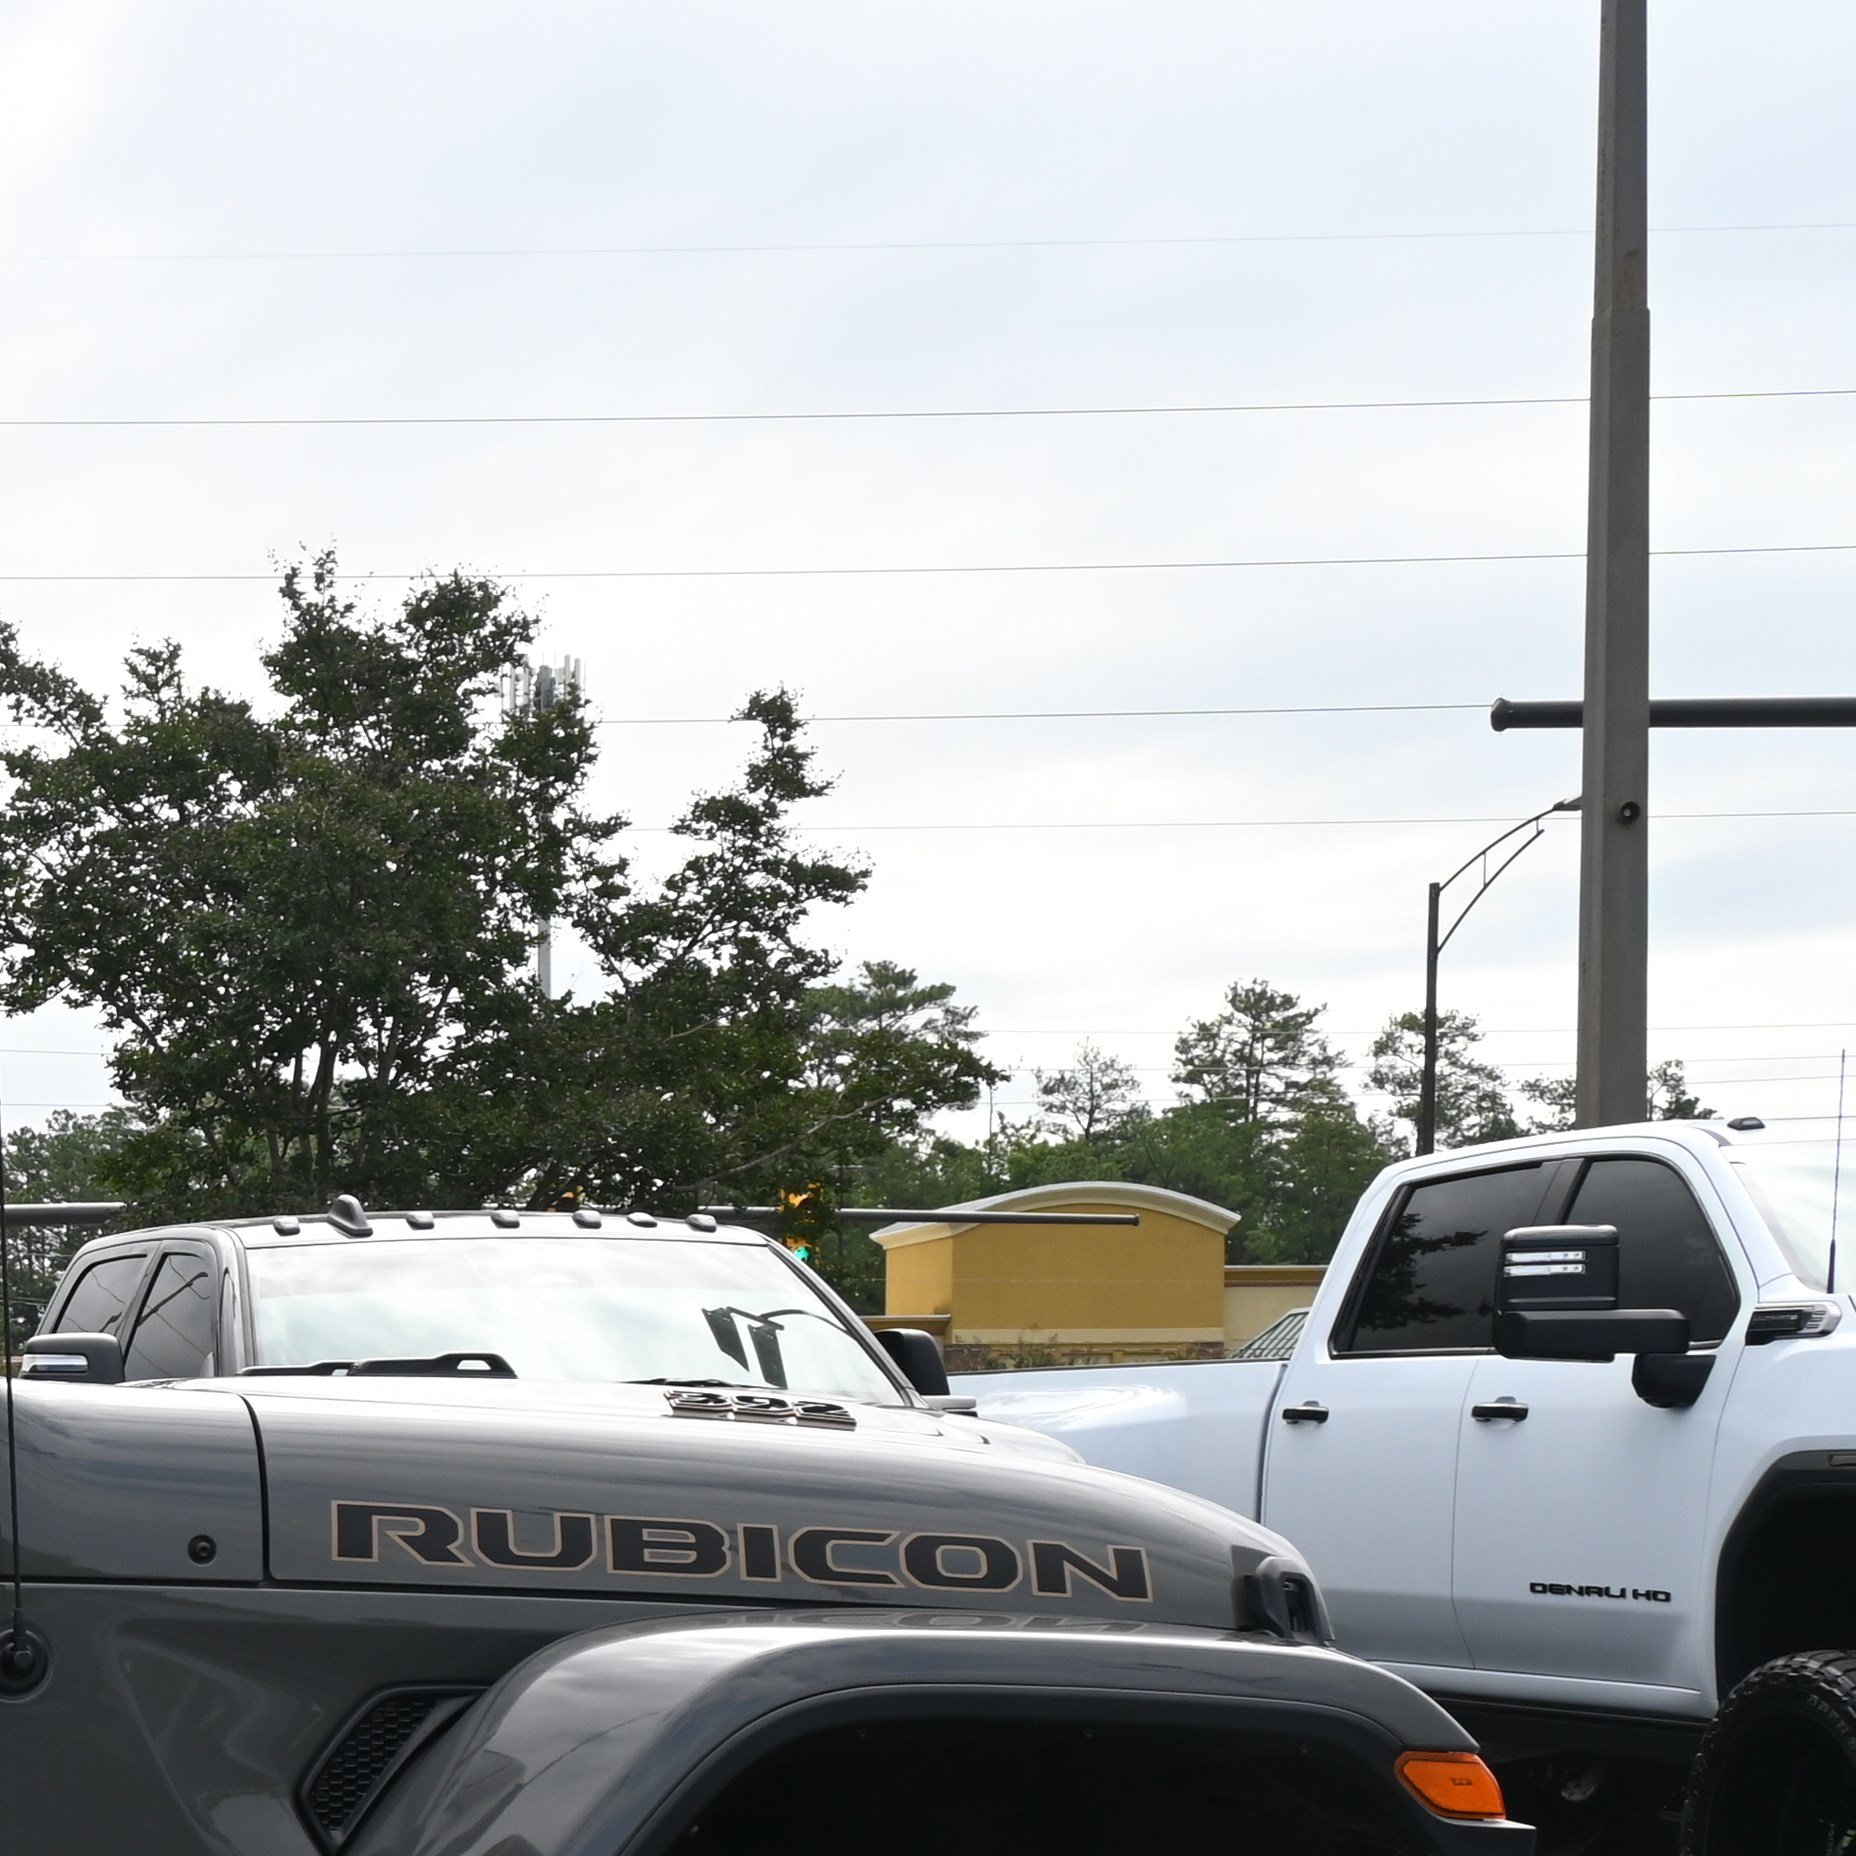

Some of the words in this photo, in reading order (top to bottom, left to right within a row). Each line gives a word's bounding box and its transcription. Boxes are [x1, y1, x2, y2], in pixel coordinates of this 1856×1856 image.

[663, 1389, 857, 1431] 392
[330, 1499, 1154, 1602] RUBICON
[1529, 1581, 1627, 1599] DENALI
[1632, 1588, 1672, 1603] HD
